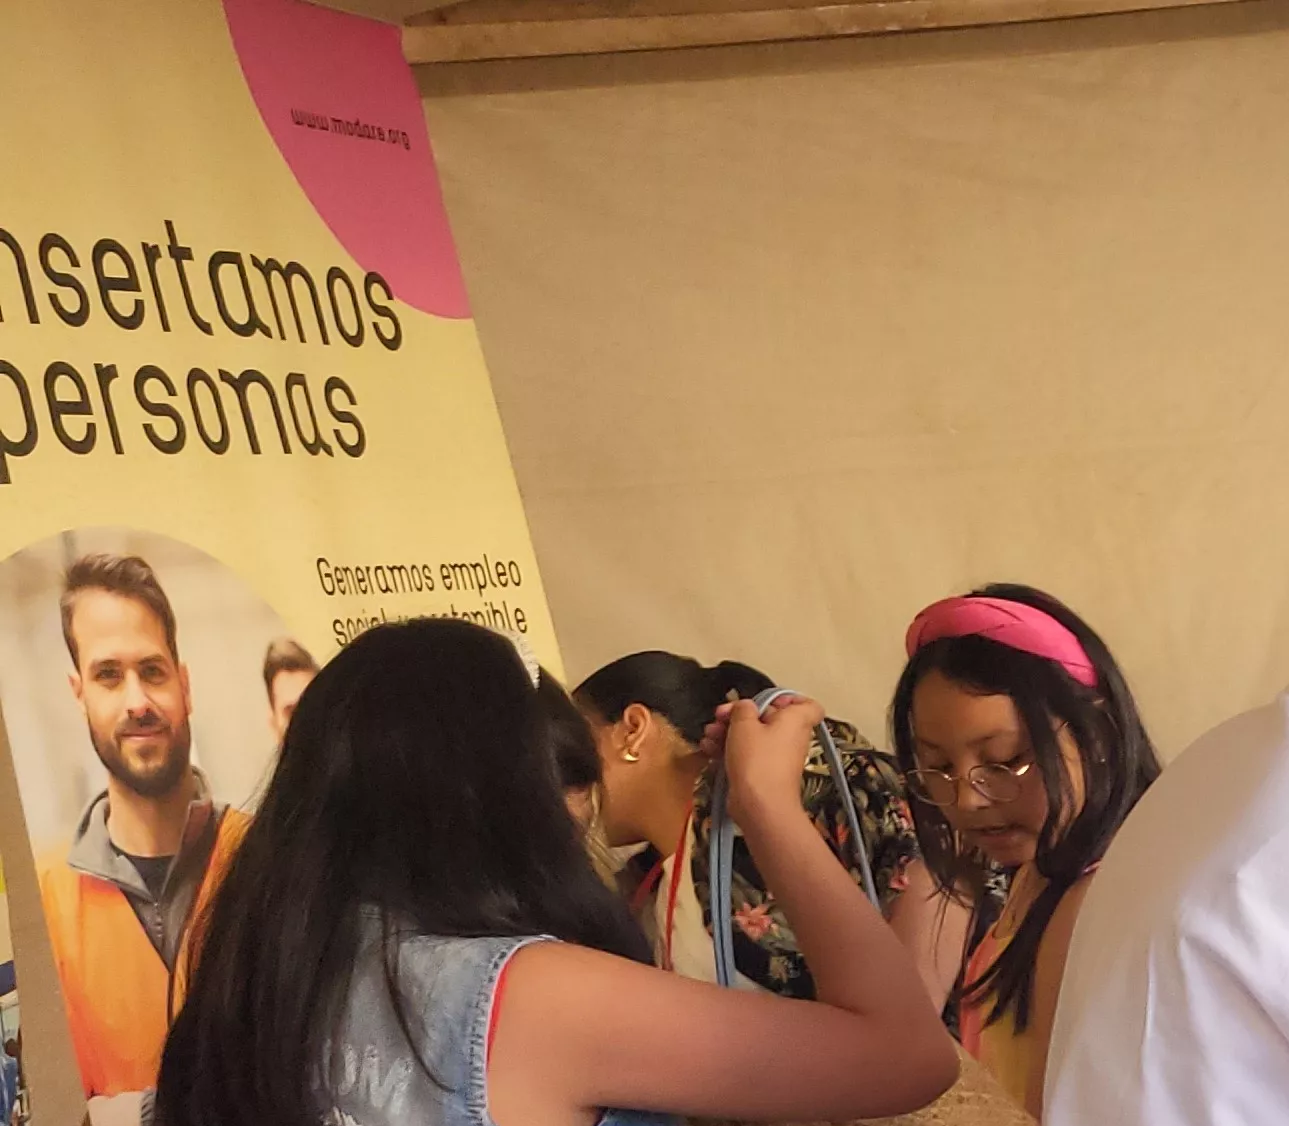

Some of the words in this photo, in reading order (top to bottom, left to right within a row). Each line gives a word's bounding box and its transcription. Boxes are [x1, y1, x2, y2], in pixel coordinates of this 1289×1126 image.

[0, 359, 366, 484] personas
[316, 557, 435, 597] Generamos
[439, 553, 521, 597] empleo
